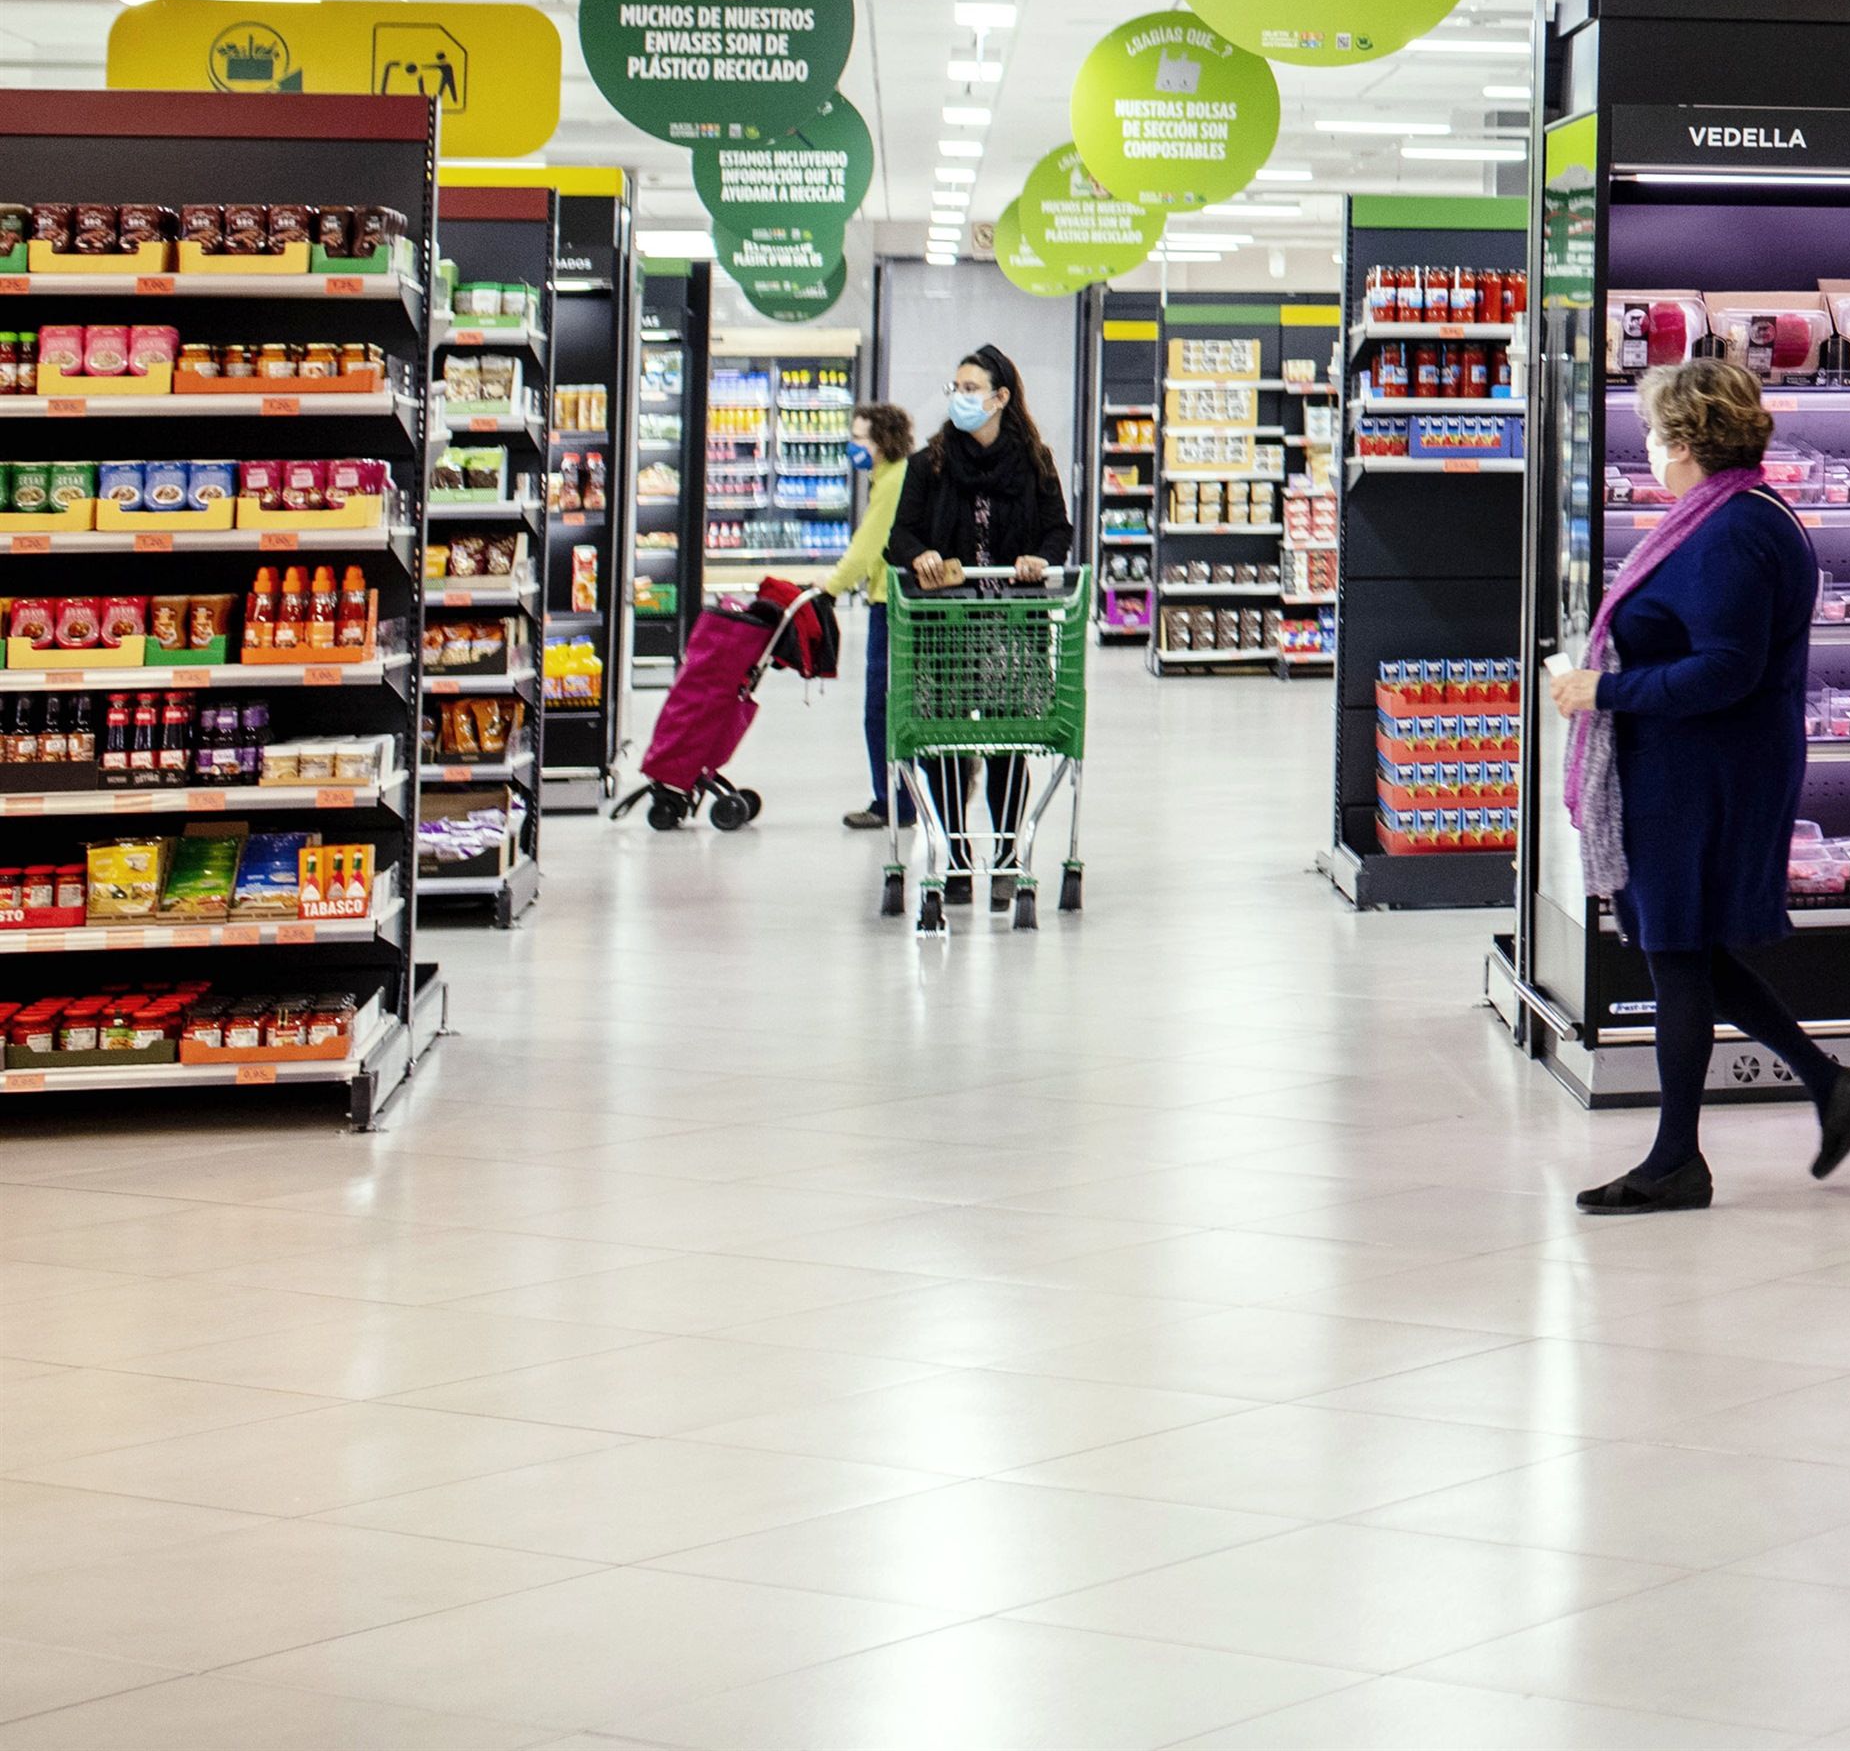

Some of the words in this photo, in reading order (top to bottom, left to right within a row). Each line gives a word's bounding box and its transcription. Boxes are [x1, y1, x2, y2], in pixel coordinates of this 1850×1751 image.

[620, 4, 694, 28] MUCHOS
[697, 6, 721, 28] DE
[724, 7, 815, 31] NUESTROS
[645, 30, 722, 55] ENVASES
[725, 33, 763, 55] SON
[765, 34, 789, 56] DE
[627, 54, 710, 80] PLÁSTICO
[713, 58, 808, 82] RECICLADO
[1115, 98, 1184, 120] NUESTRAS
[1187, 101, 1237, 121] BOLSAS
[1122, 120, 1141, 138] DE
[1143, 118, 1198, 139] SECCIÓN
[1200, 122, 1228, 140] SON
[1688, 126, 1807, 149] VEDELLA
[1123, 140, 1227, 161] COMPOSTABLES
[303, 898, 364, 918] TABASCO
